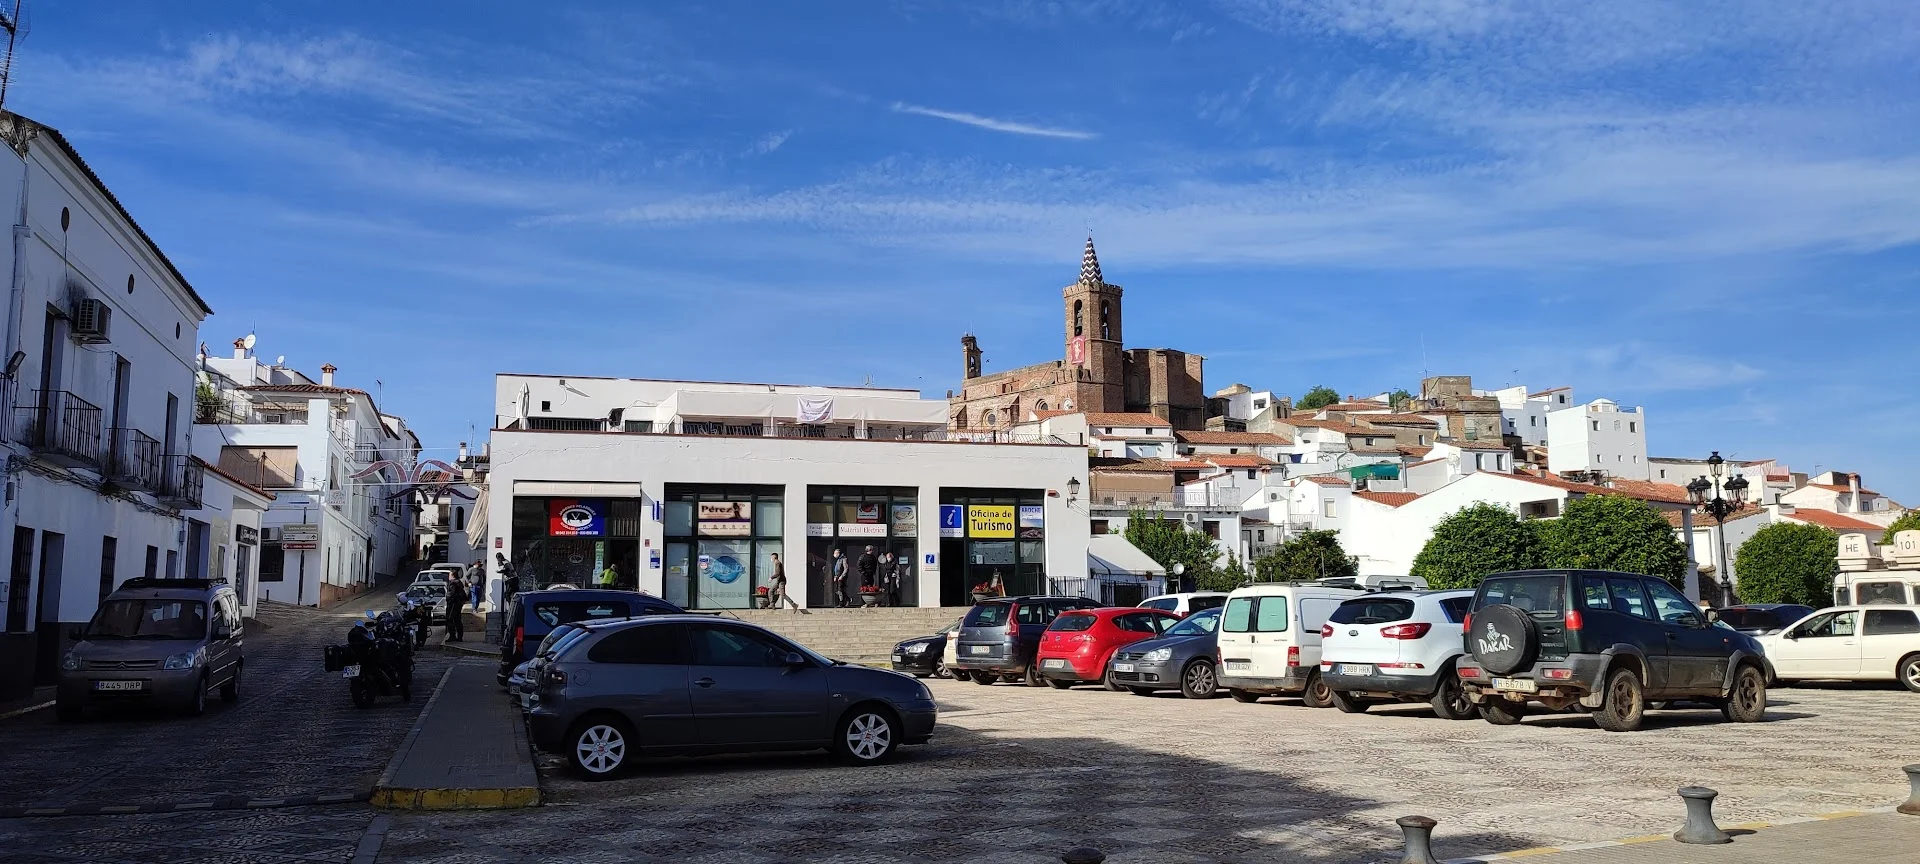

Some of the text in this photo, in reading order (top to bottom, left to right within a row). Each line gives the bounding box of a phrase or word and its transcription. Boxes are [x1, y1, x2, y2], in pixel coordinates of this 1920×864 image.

[701, 505, 732, 513] Pérez
[970, 509, 999, 518] Oficina
[1002, 510, 1012, 518] de
[971, 519, 1012, 531] Turismo
[1845, 544, 1858, 553] HE
[1900, 541, 1916, 550] 101
[1478, 634, 1514, 654] DAKAR
